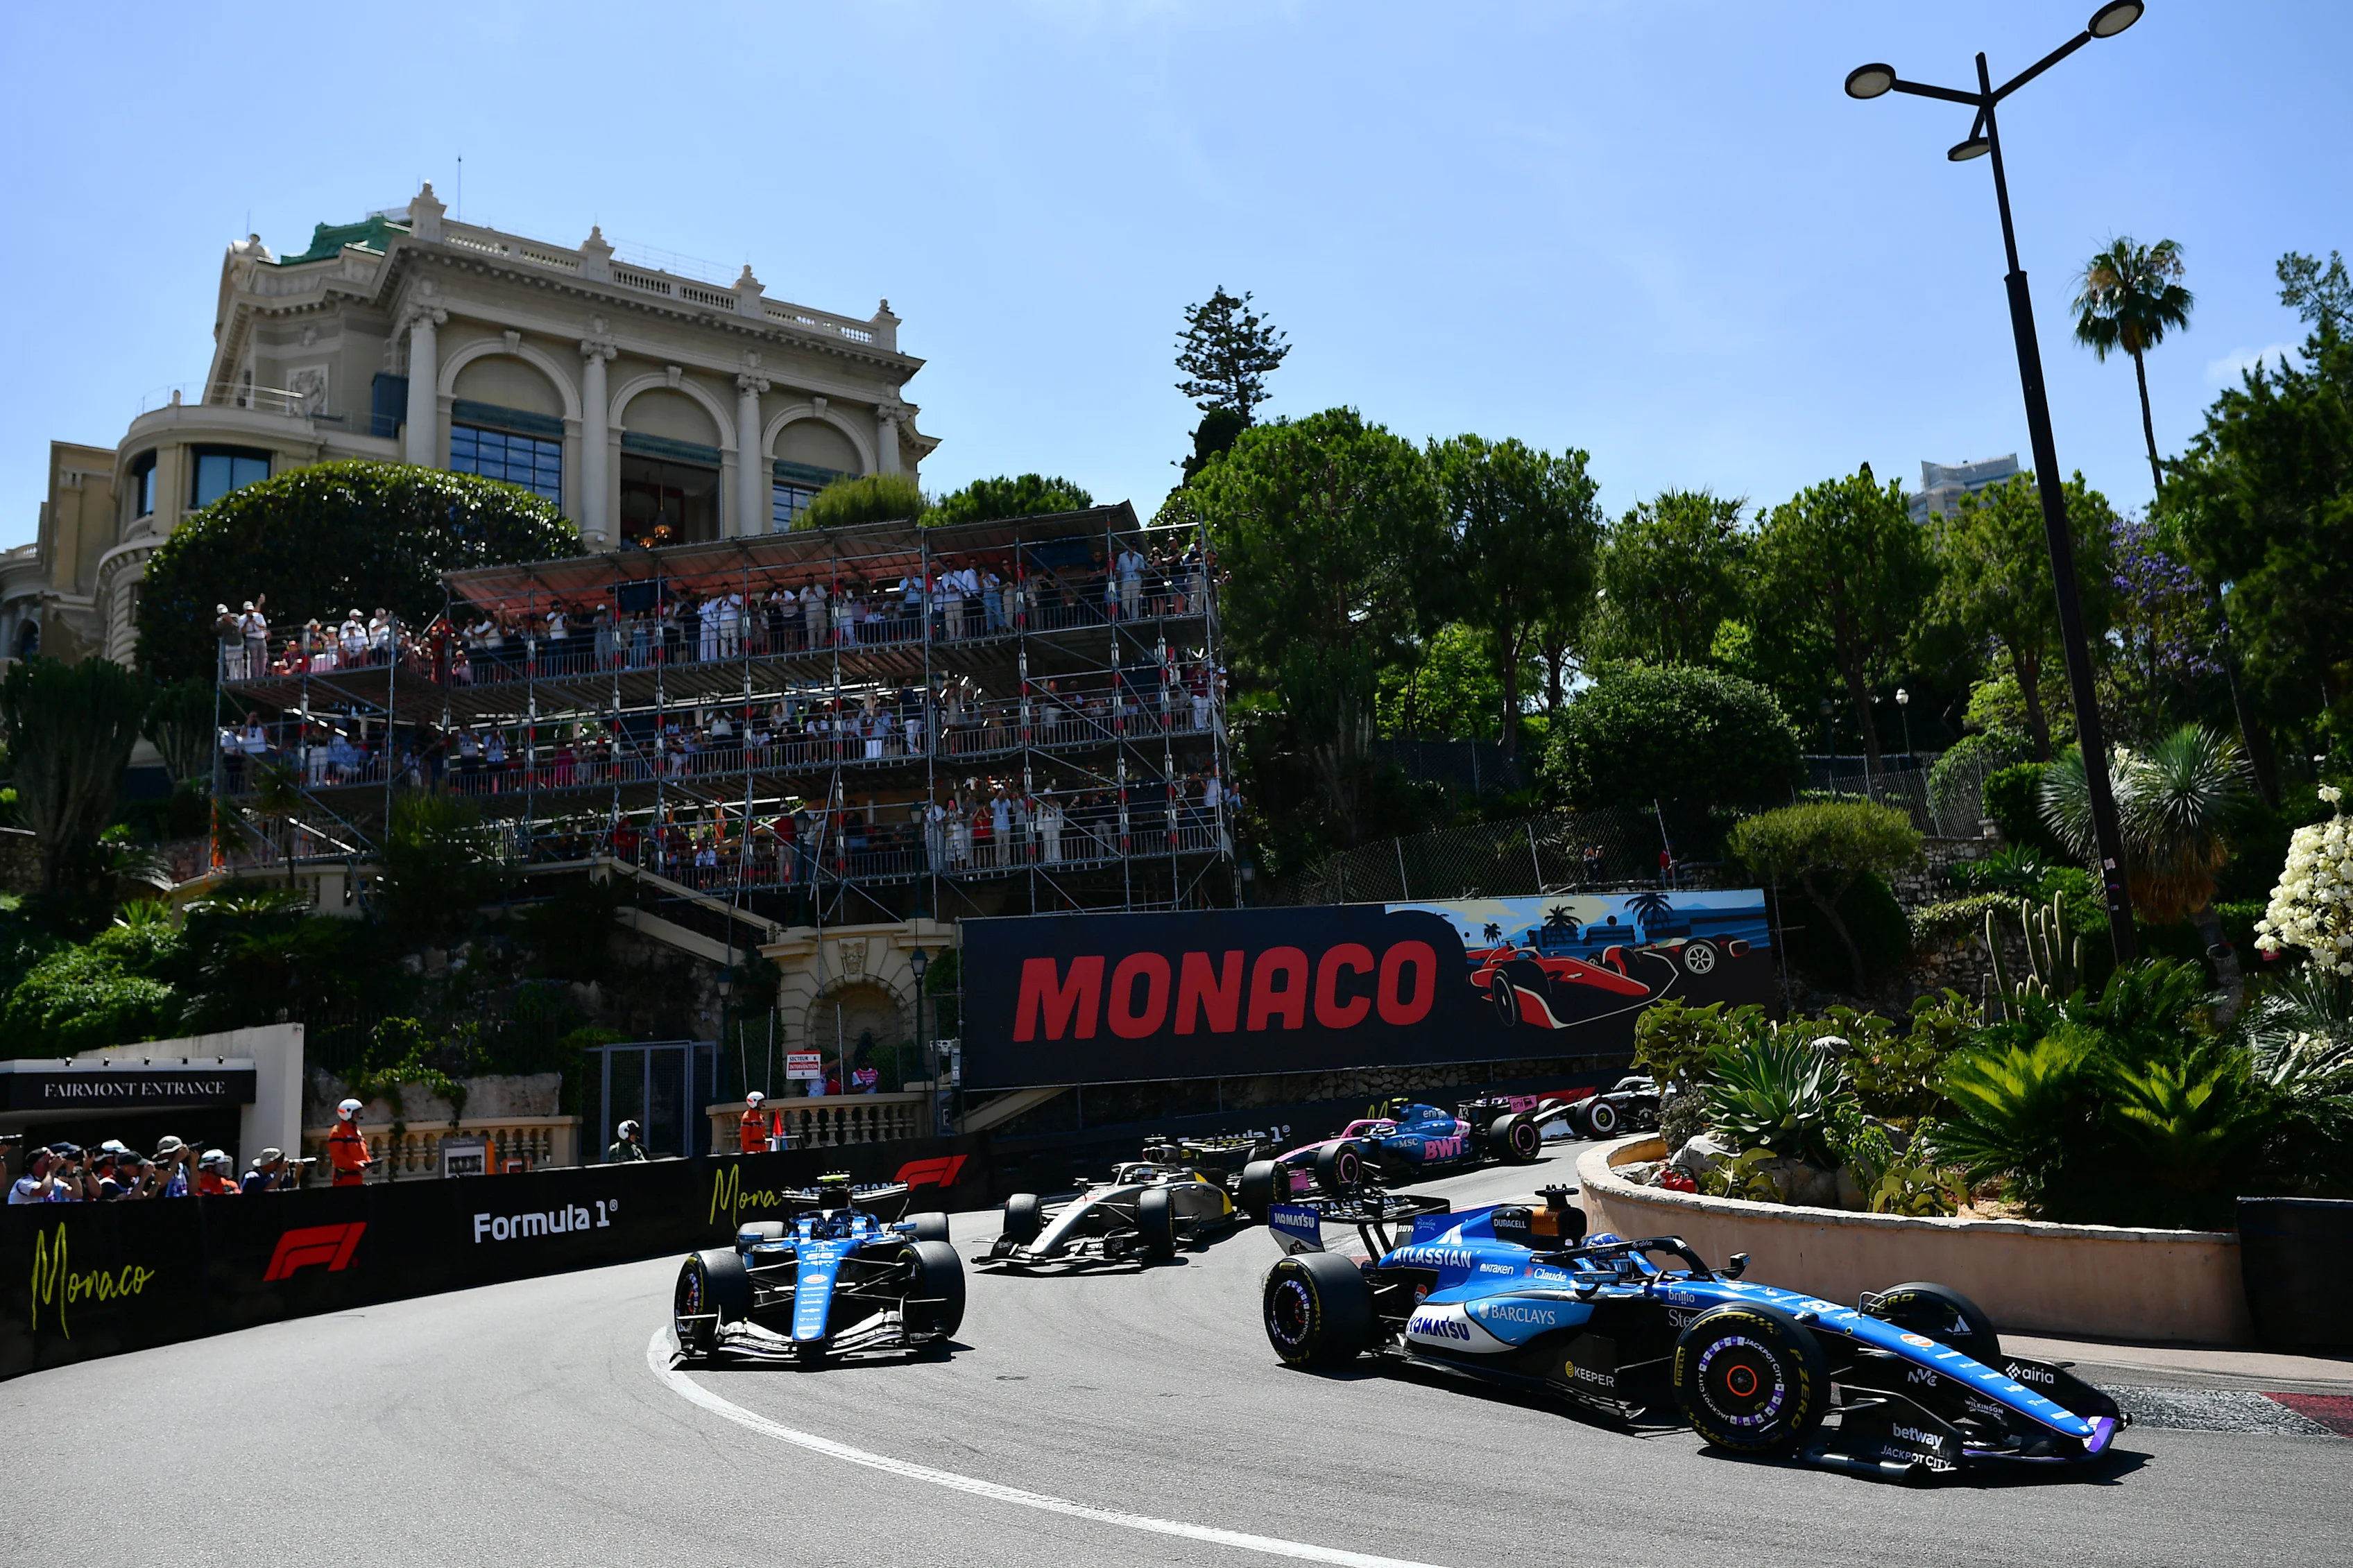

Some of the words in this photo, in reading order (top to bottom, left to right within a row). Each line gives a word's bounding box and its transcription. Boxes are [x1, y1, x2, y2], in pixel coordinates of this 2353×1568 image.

[1013, 940, 1437, 1042] MONACO
[44, 1083, 137, 1098] FAIRMONT
[142, 1080, 225, 1096] ENTRANCE
[1398, 1137, 1419, 1148] MSC
[1424, 1136, 1462, 1160] BWT
[474, 1204, 590, 1243] Formula
[1274, 1212, 1315, 1228] KOMATSU
[1494, 1218, 1527, 1229] DURACELL
[1393, 1247, 1472, 1268] ATLASSIAN
[31, 1222, 155, 1340] Monaco
[1534, 1268, 1567, 1282] Claude
[1491, 1304, 1556, 1325] BARCLAYS
[1407, 1316, 1471, 1341] KOMATSU
[1675, 1345, 1686, 1387] PIRELLI
[1743, 1338, 1776, 1363] JACKPOT
[1772, 1363, 1783, 1383] CITY
[1574, 1366, 1614, 1388] KEEPER
[2022, 1367, 2054, 1384] airia
[1702, 1393, 1730, 1421] JACKPOT
[1965, 1399, 2003, 1415] WILKINSON
[1892, 1422, 1944, 1450] betway
[1881, 1445, 1924, 1465] JACKPOT
[1925, 1456, 1952, 1470] CITY
